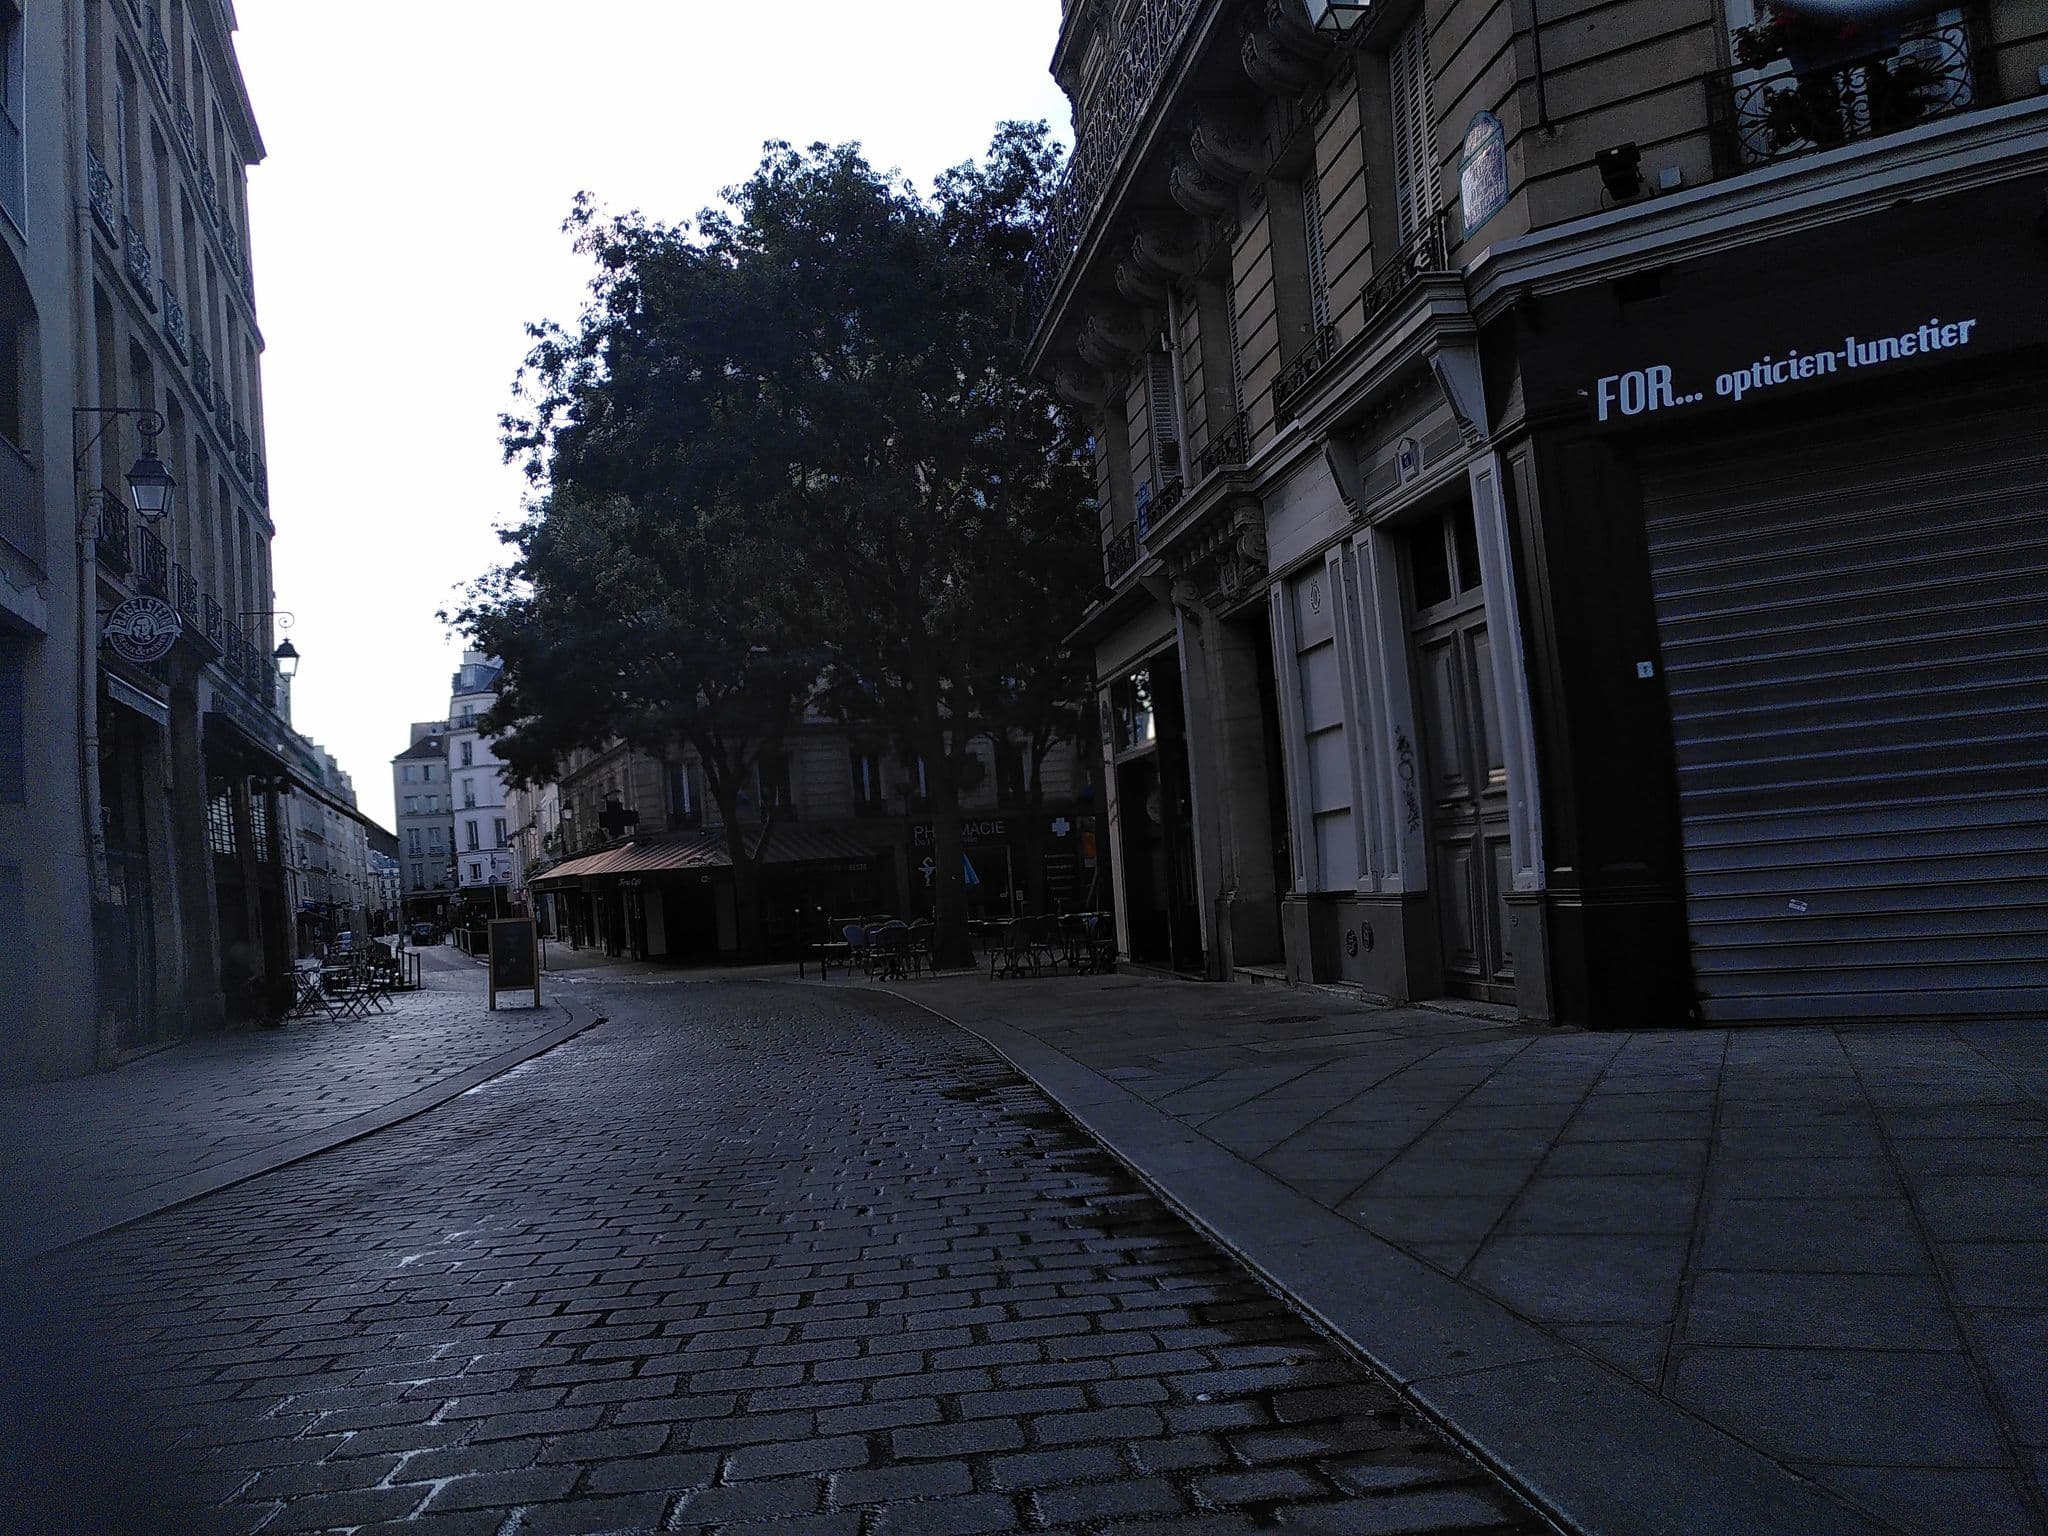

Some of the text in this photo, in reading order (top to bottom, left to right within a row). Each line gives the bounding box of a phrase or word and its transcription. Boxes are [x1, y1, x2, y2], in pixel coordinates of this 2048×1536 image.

[1715, 317, 1977, 402] opticien-lunetier
[112, 598, 174, 627] BAGELSTEIN
[912, 820, 1006, 839] PHMACIE
